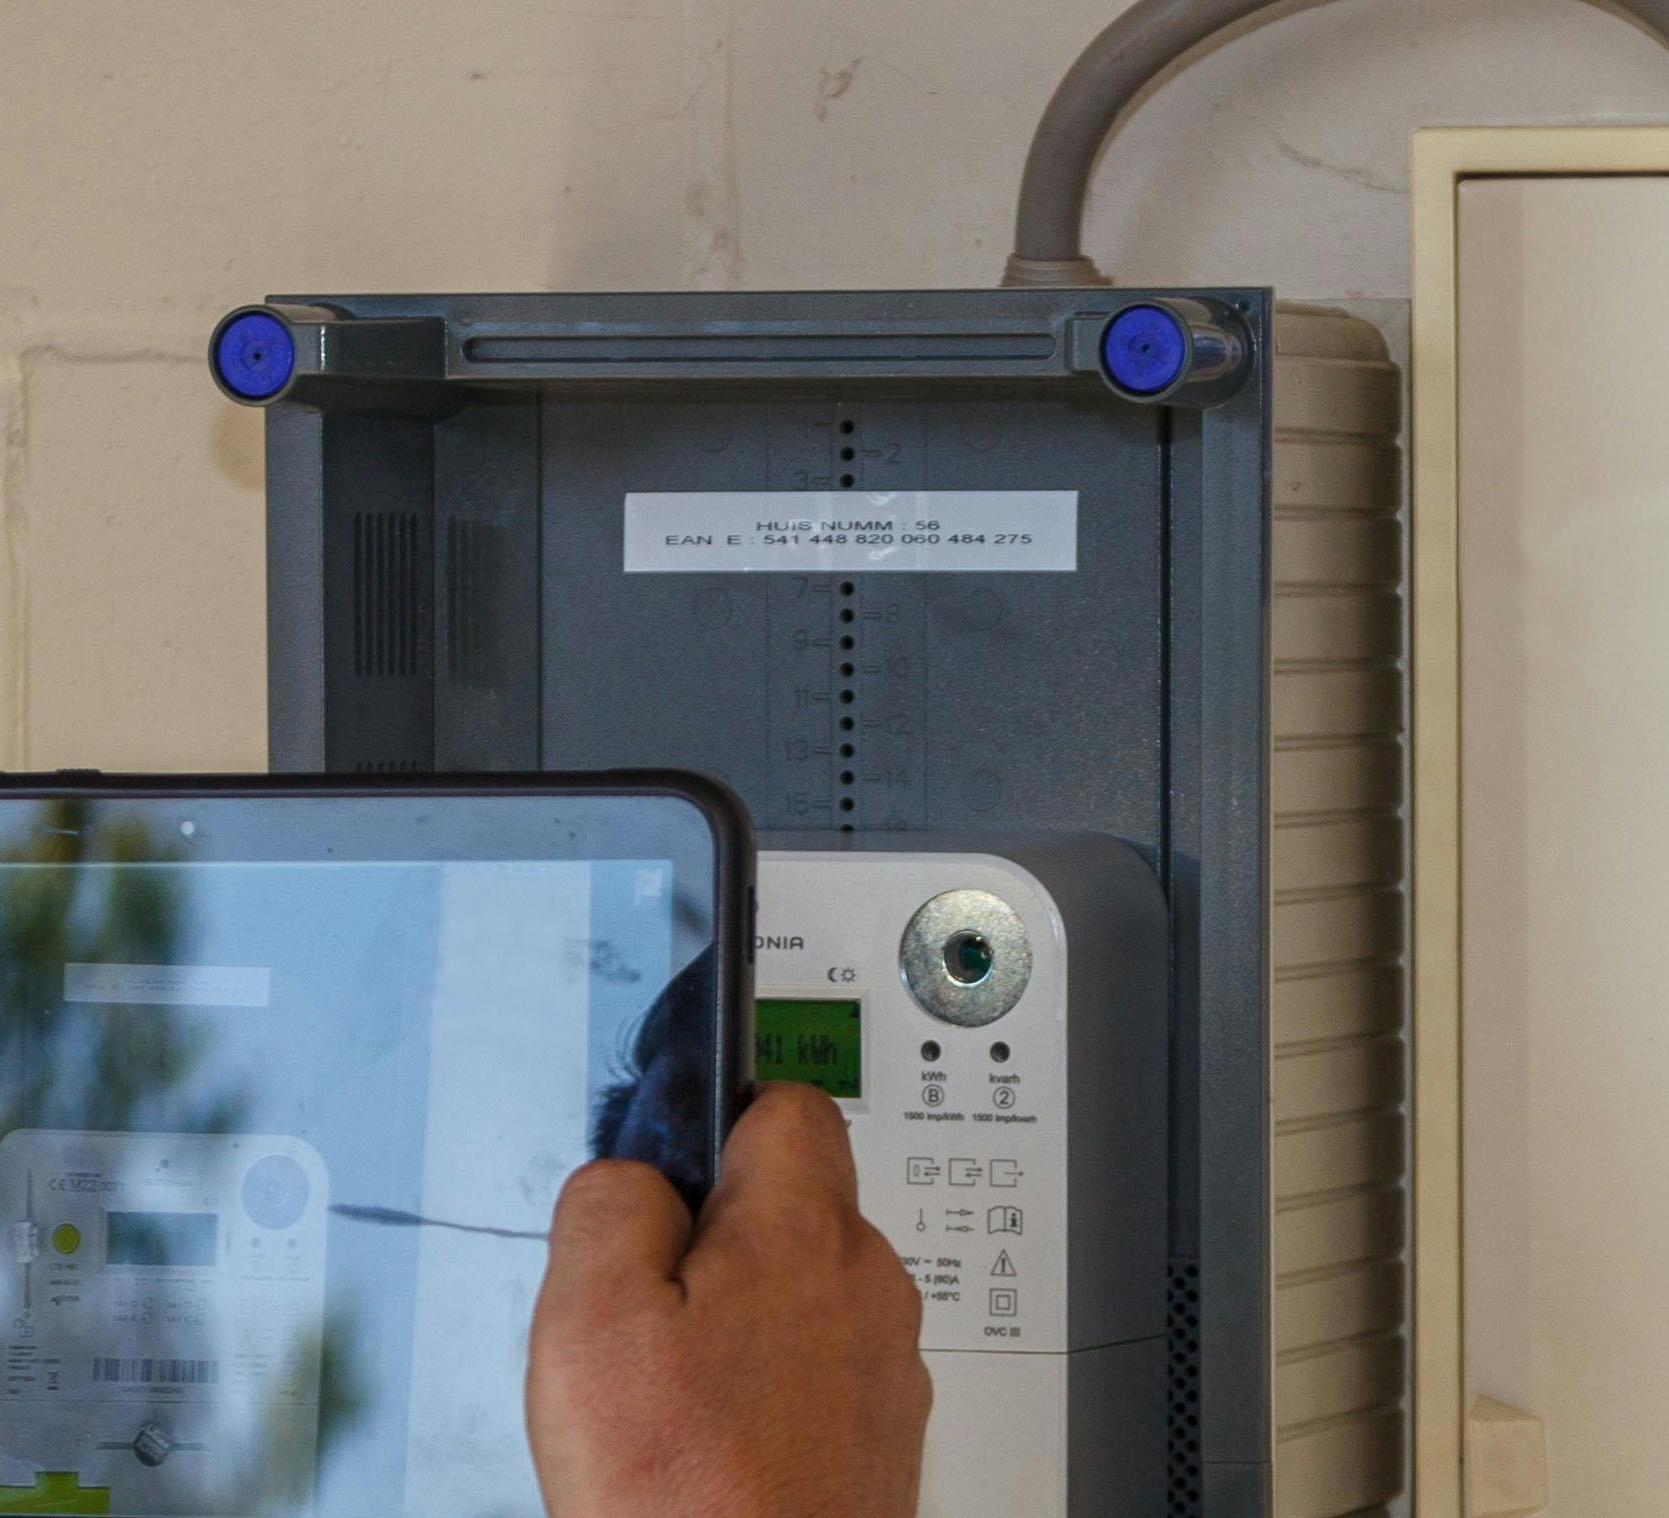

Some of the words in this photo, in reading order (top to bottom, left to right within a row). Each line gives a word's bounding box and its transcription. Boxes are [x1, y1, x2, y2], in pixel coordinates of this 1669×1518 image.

[886, 442, 901, 465] 2
[756, 520, 811, 531] HUIS
[821, 520, 893, 531] NUMM
[914, 520, 941, 531] 56
[665, 534, 712, 545] EAN
[726, 534, 742, 545] E
[763, 534, 800, 545] 541
[809, 534, 848, 545] 448
[855, 533, 894, 544] 820
[900, 533, 940, 544] 060
[948, 533, 986, 544] 484
[993, 533, 1033, 544] 275
[792, 575, 809, 599] 7
[921, 1070, 947, 1082] kWh
[988, 1072, 1021, 1084] kvarh
[983, 1326, 1007, 1337] OVC
